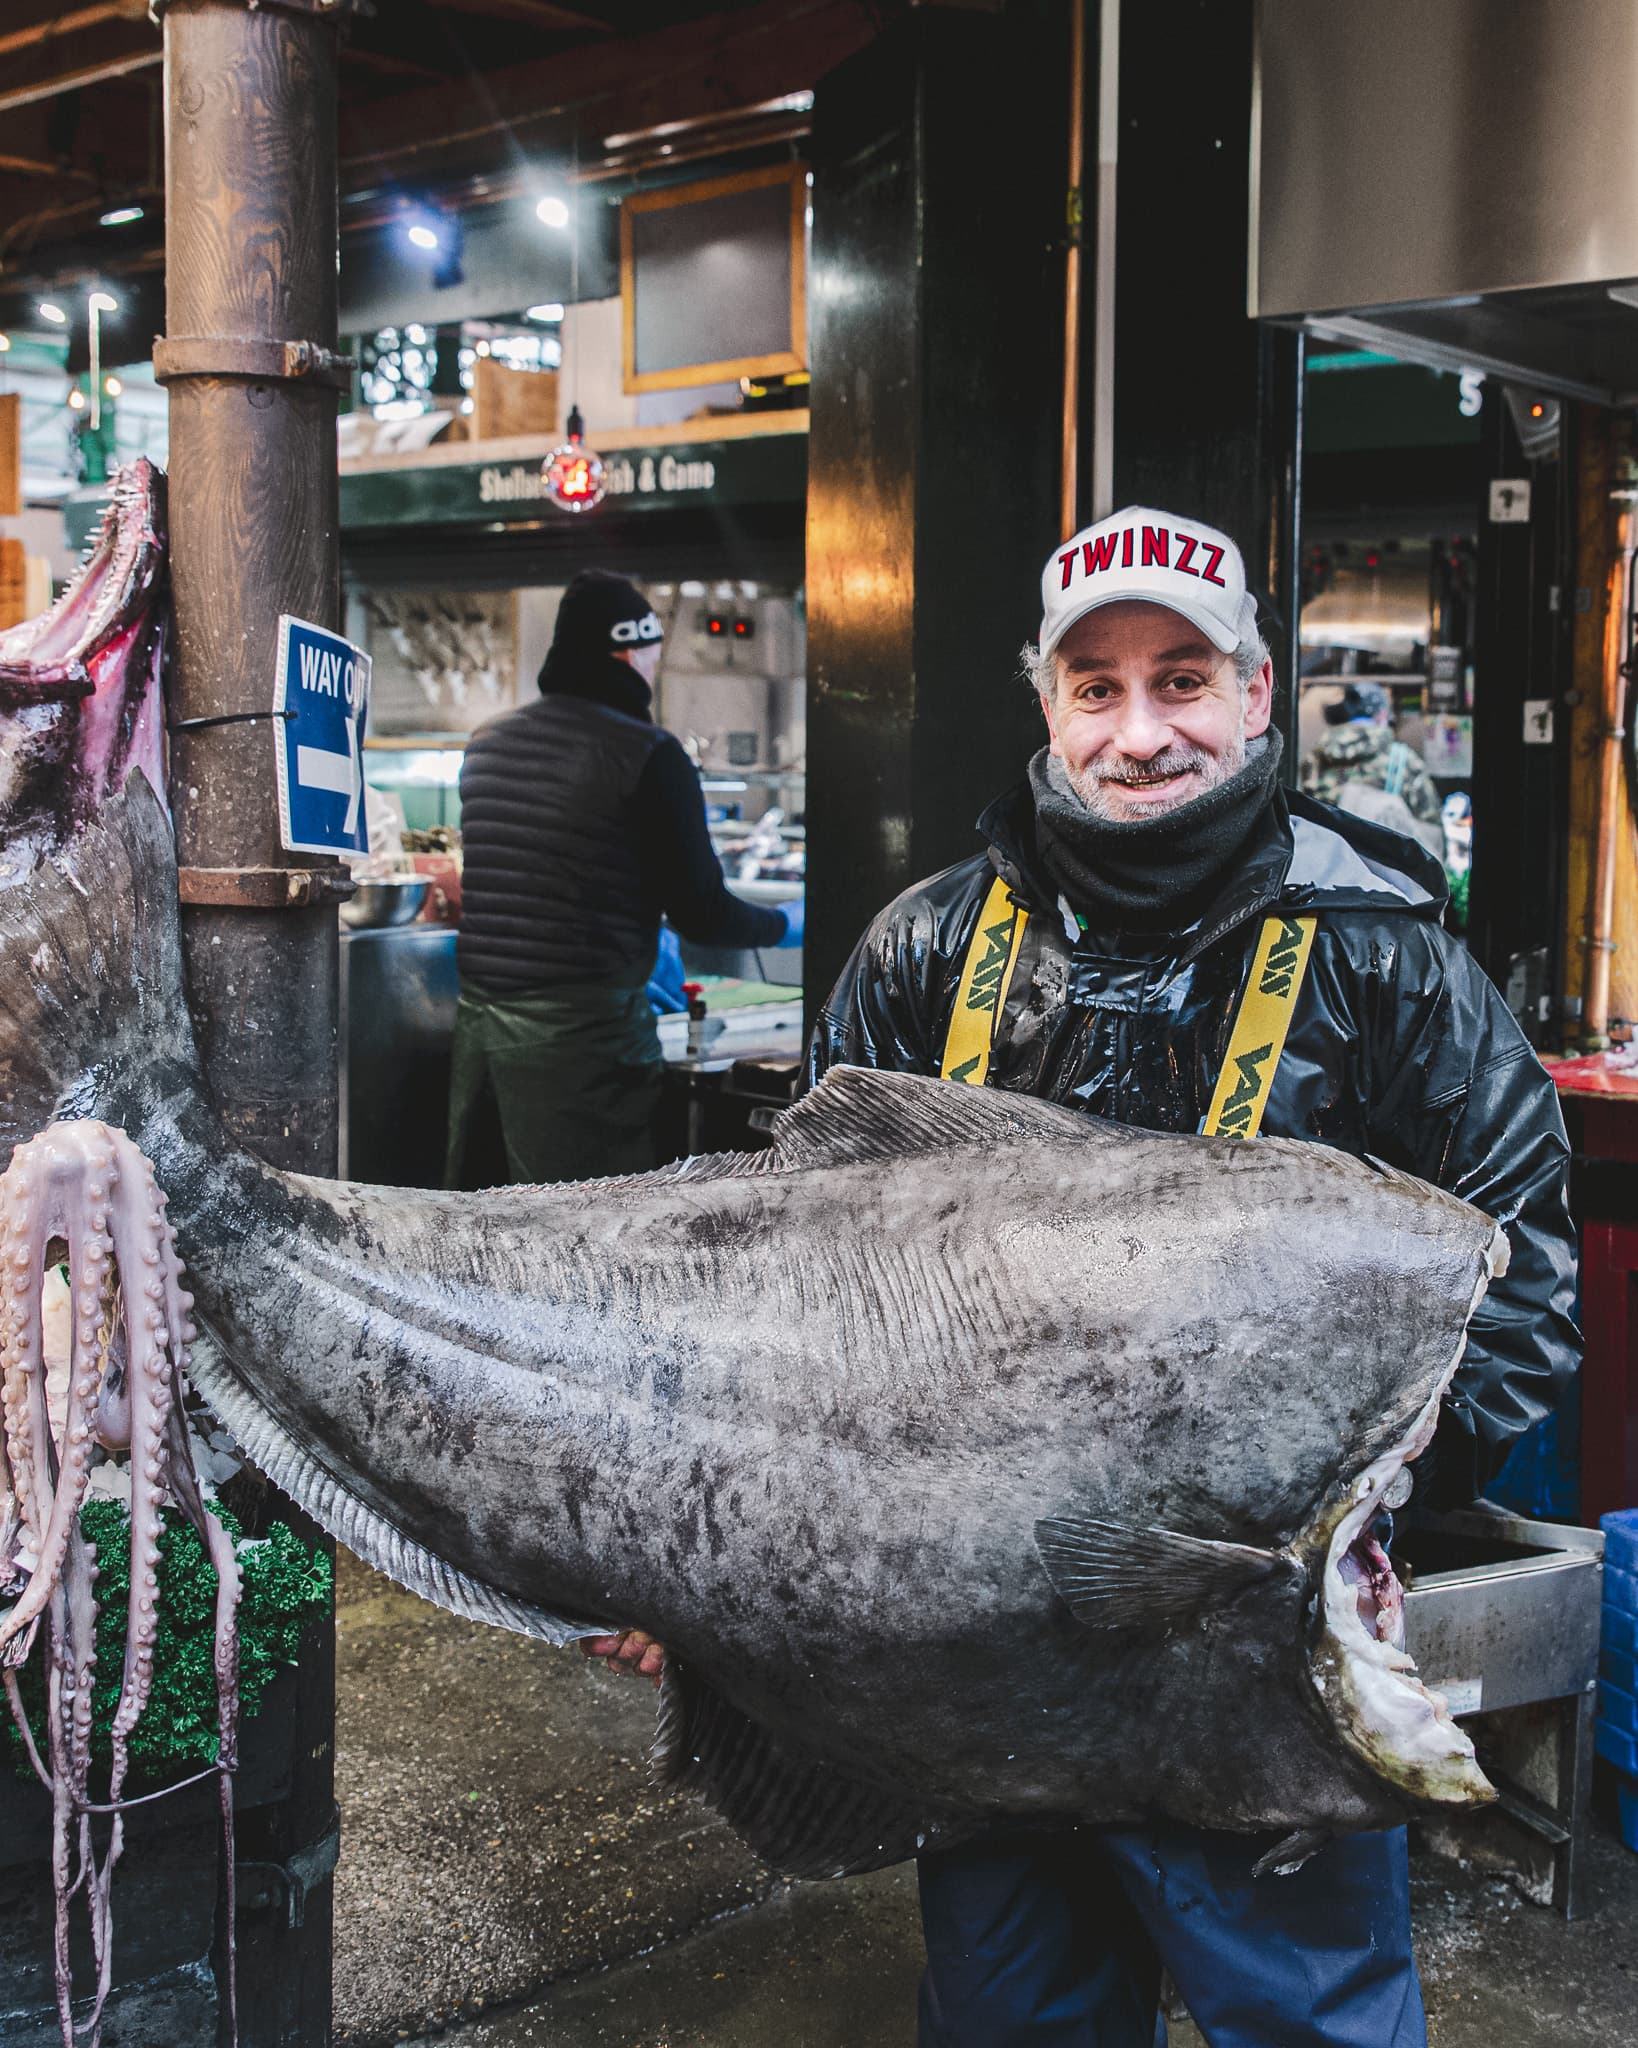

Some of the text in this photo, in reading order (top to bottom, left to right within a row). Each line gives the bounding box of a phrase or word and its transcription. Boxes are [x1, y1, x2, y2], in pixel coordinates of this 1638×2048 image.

[638, 456, 656, 492] &
[1058, 526, 1226, 591] TWINZZ
[300, 643, 342, 698] WAY
